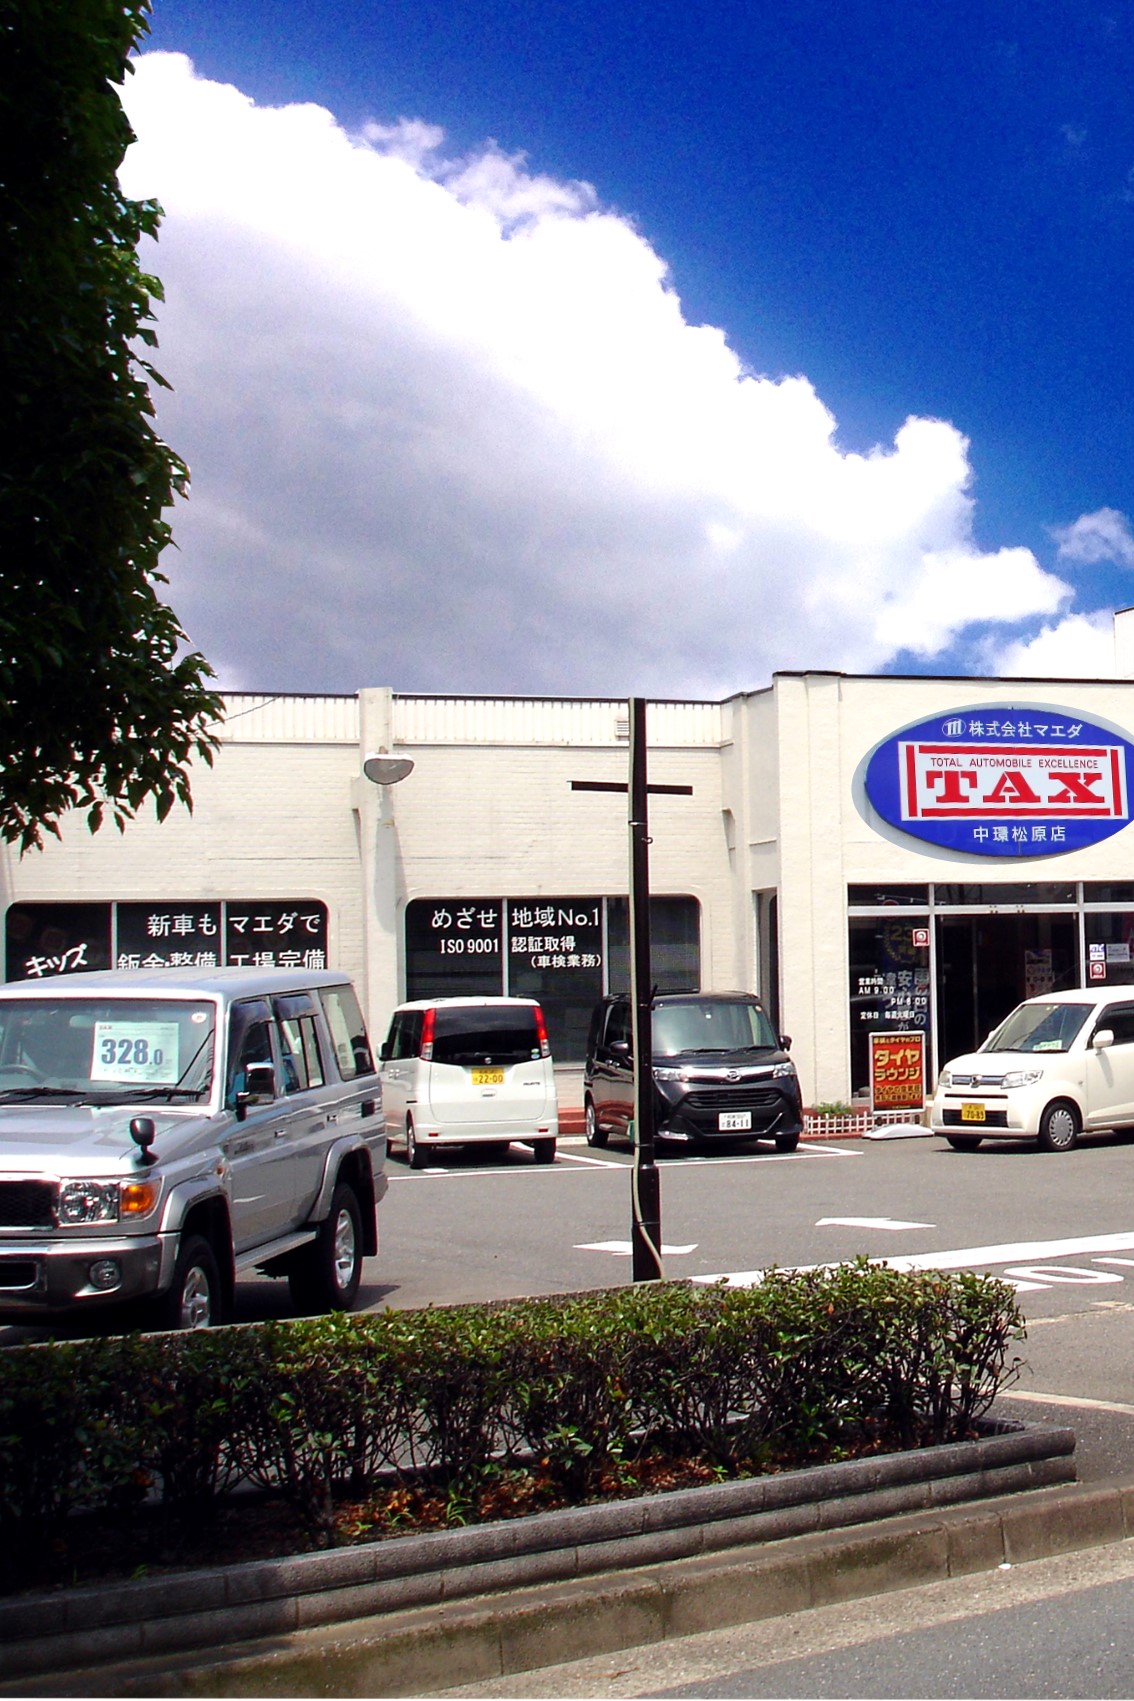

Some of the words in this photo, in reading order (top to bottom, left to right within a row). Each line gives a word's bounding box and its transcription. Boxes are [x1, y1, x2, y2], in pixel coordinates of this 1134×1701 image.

[969, 720, 1083, 738] 株式会社マエダ
[930, 757, 963, 767] TOTAL
[969, 758, 1032, 768] AUTOMOBILE
[1039, 759, 1099, 769] EXCELLENCE
[926, 770, 1106, 804] TAX
[973, 826, 1066, 843] 中環松原店
[147, 914, 217, 937] 新車も
[229, 912, 320, 935] マエダで
[431, 907, 498, 929] めざせ
[511, 906, 599, 929] 地域No.1
[440, 939, 464, 954] ISO
[467, 938, 499, 954] 9001
[511, 936, 576, 953] 認証取得
[874, 1049, 920, 1066] タイヤ
